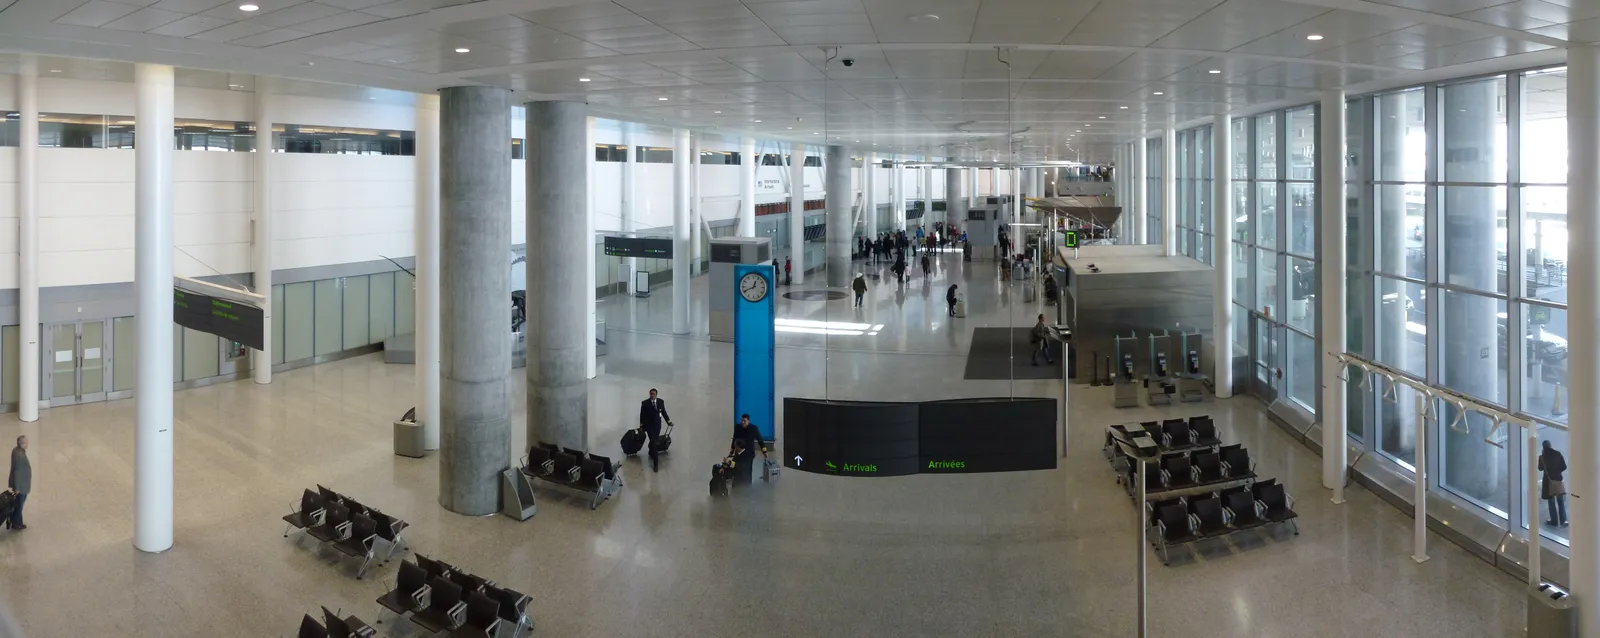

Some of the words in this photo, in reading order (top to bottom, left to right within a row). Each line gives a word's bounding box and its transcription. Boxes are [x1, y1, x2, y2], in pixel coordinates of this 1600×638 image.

[1066, 232, 1076, 246] D
[843, 463, 877, 472] Arrivals
[928, 460, 965, 468] Arrivées
